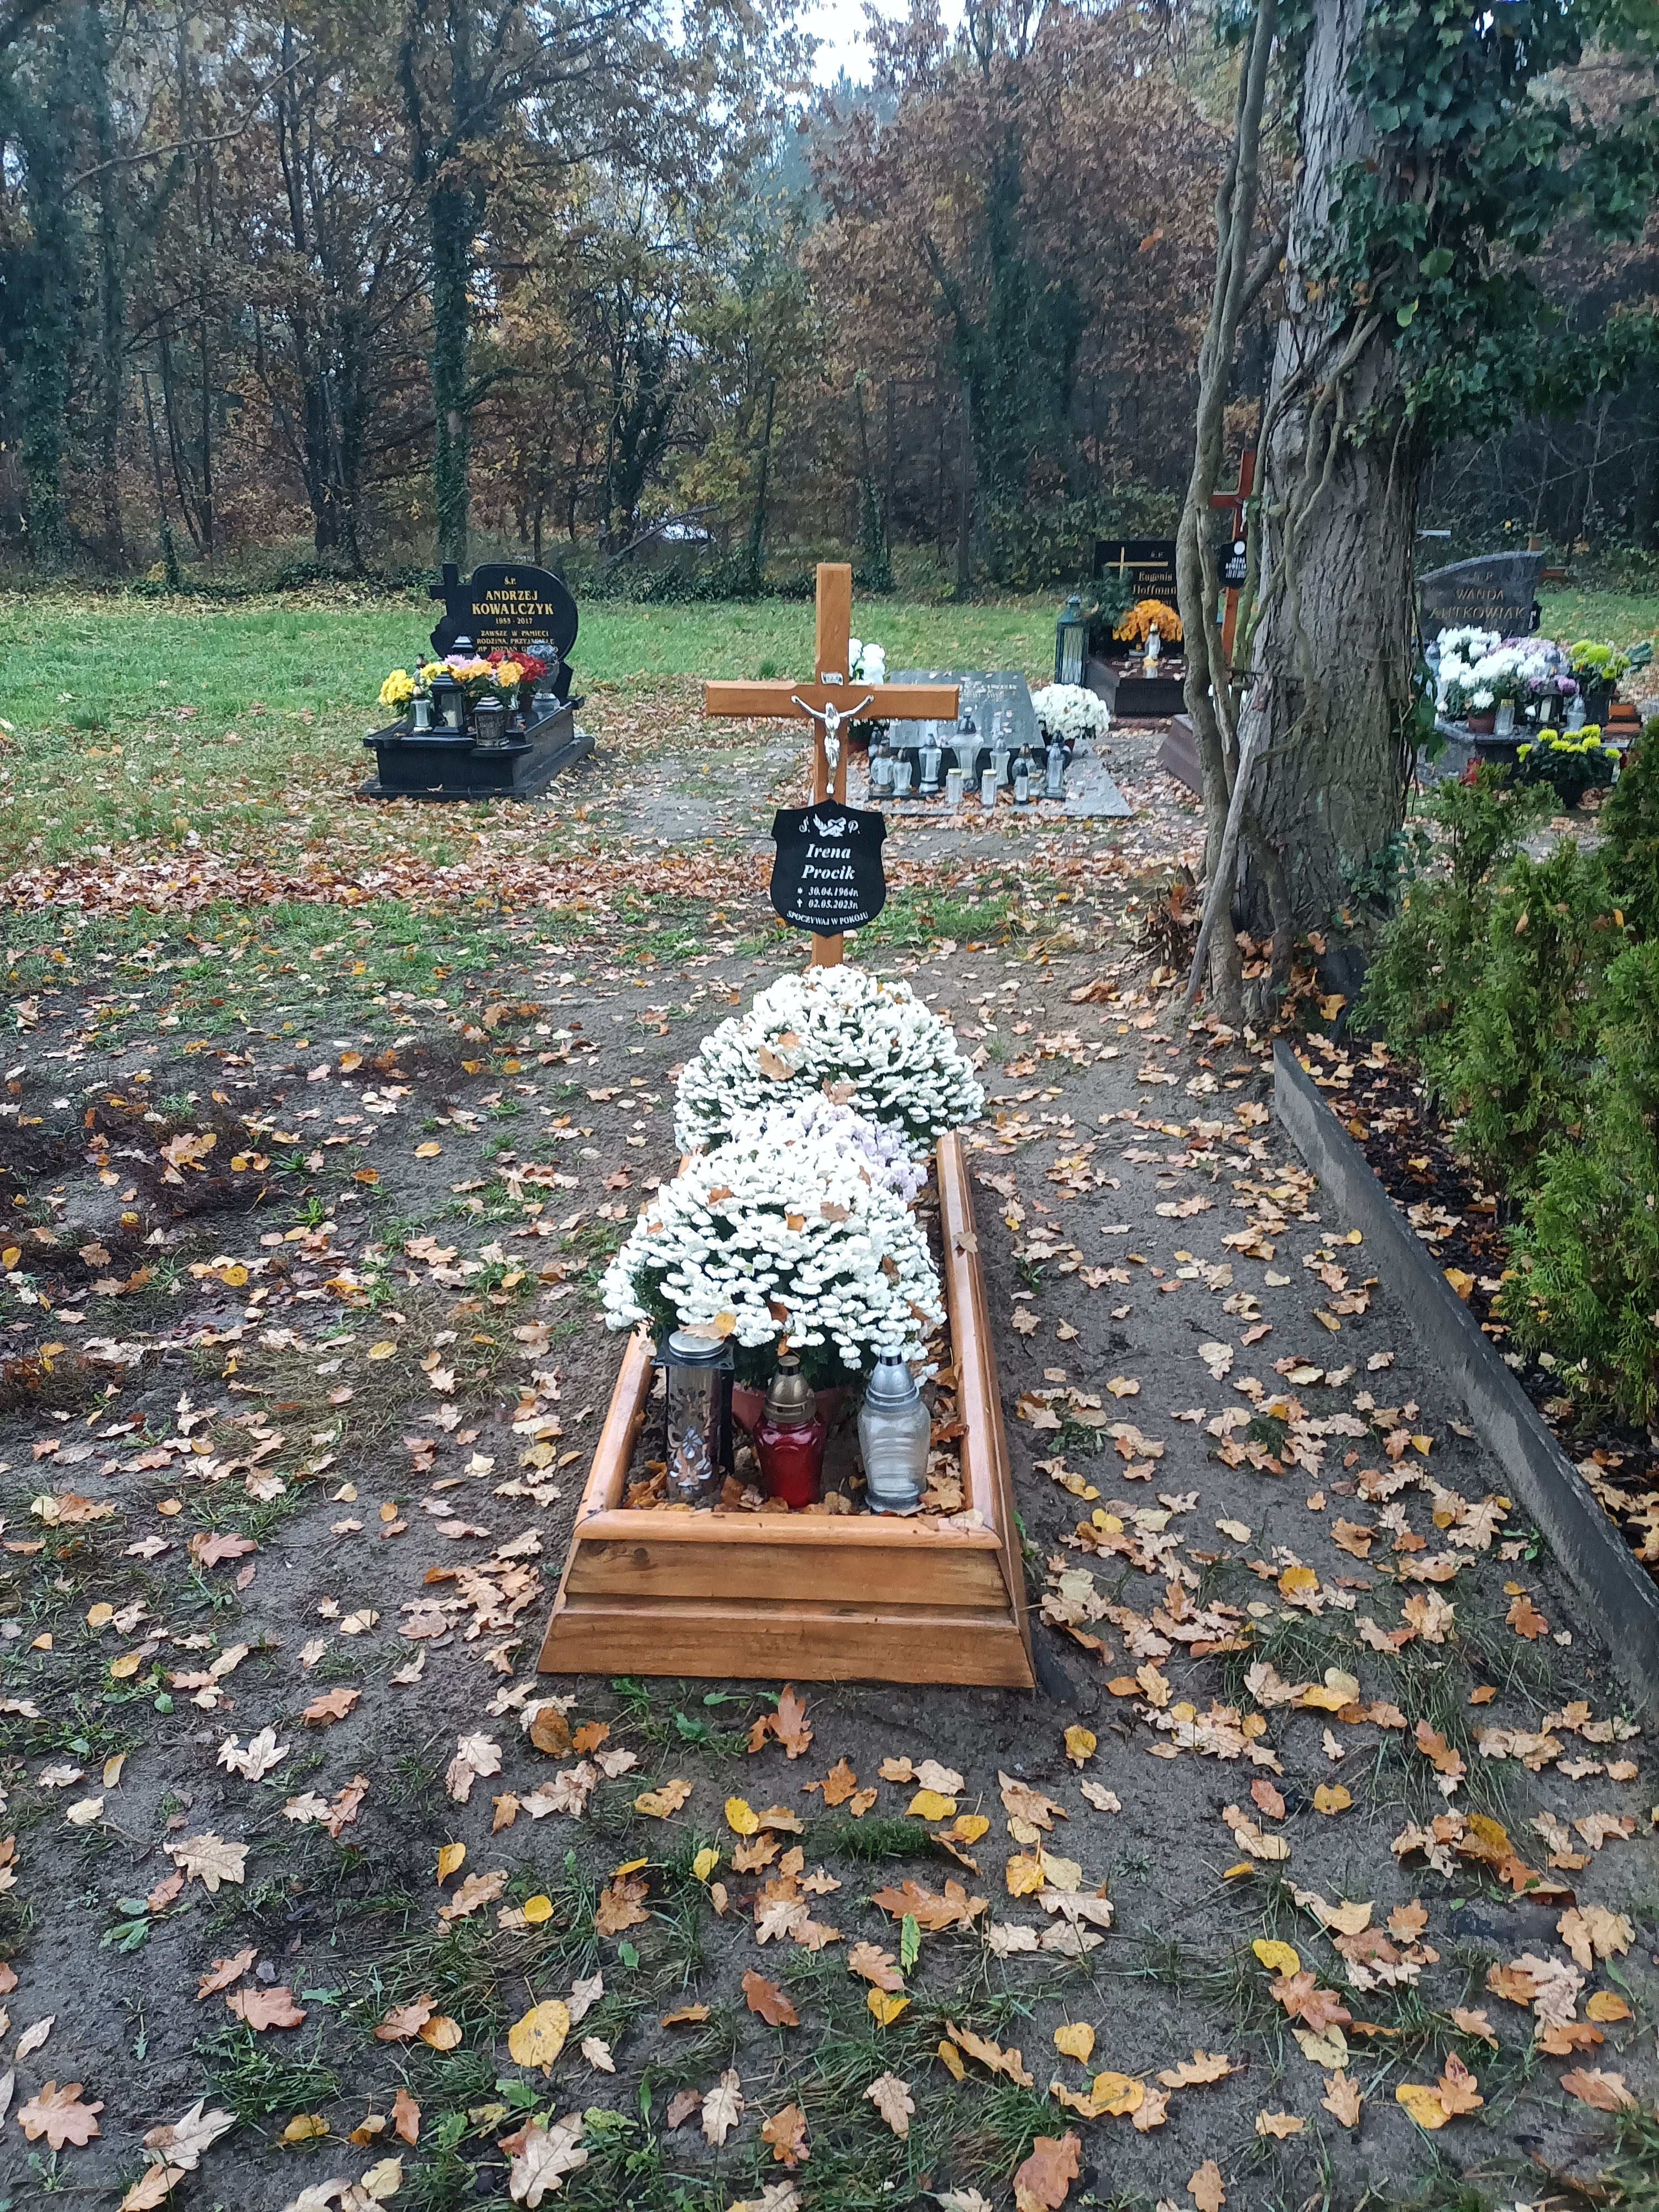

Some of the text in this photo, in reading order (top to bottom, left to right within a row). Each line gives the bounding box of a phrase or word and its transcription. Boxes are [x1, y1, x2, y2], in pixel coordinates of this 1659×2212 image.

[486, 590, 539, 601] ANDRZEJ
[1456, 588, 1504, 601] WANDA
[472, 603, 555, 615] KOWALCZYK
[517, 617, 534, 625] 2017
[805, 843, 852, 859] Irena
[801, 864, 856, 880] Procik
[786, 910, 869, 926] SPOCZYWAJ W POKOJU
